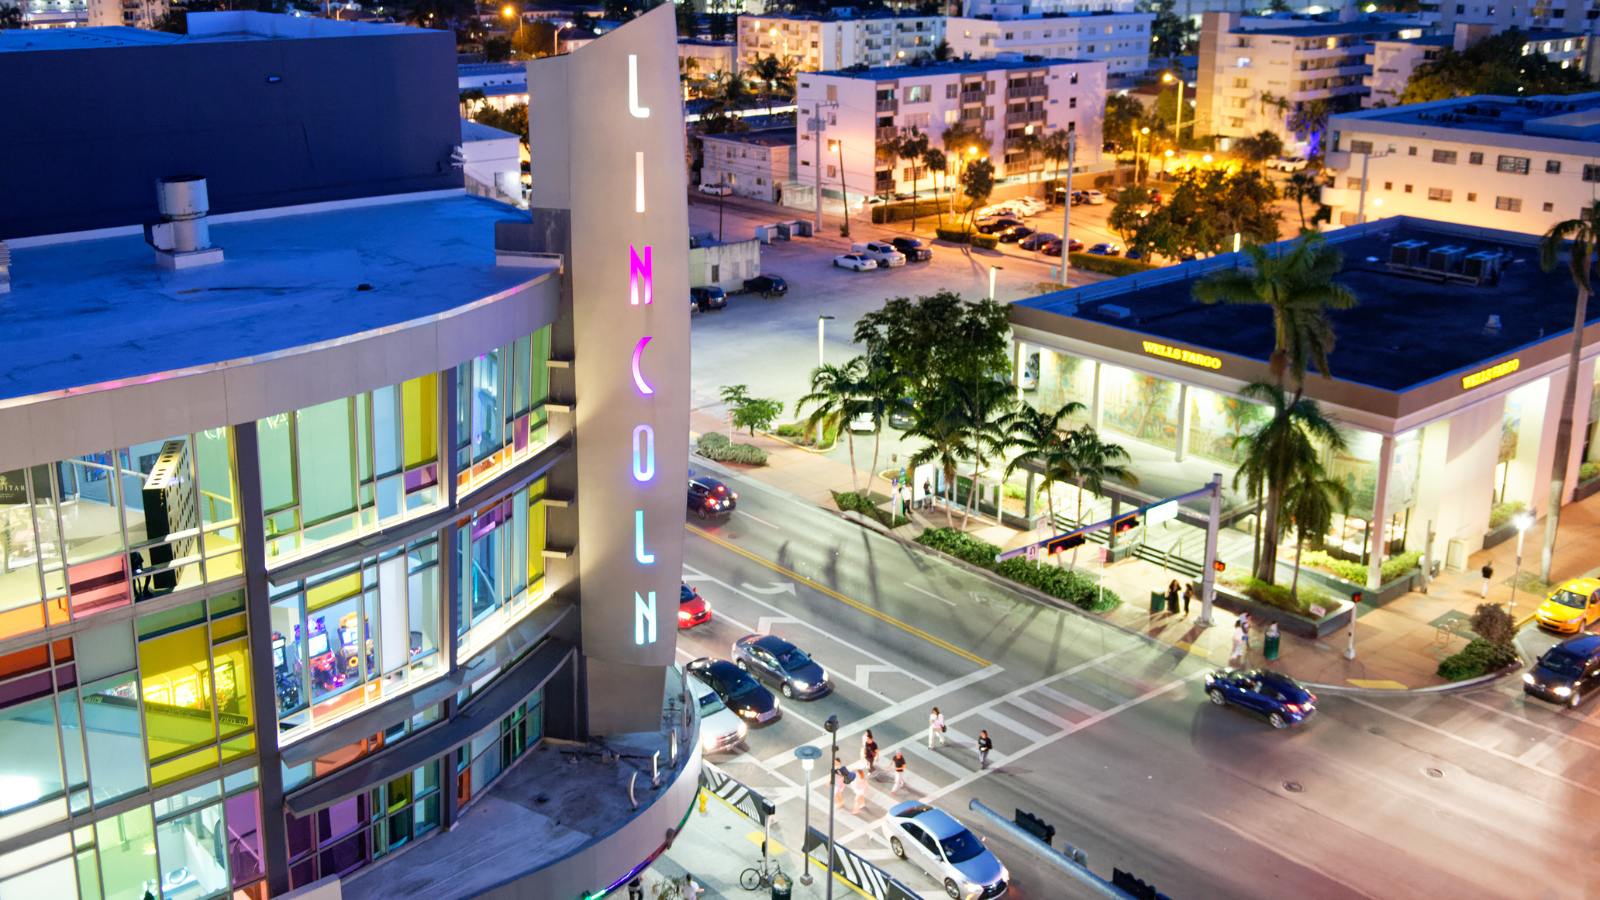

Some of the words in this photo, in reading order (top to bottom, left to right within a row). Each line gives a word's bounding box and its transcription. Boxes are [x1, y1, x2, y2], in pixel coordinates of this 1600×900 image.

[628, 54, 657, 645] LINCOLN
[1142, 340, 1182, 360] WELLS
[1181, 350, 1222, 370] FARGO
[1462, 368, 1492, 389] WELLS
[1491, 358, 1519, 379] FARGO
